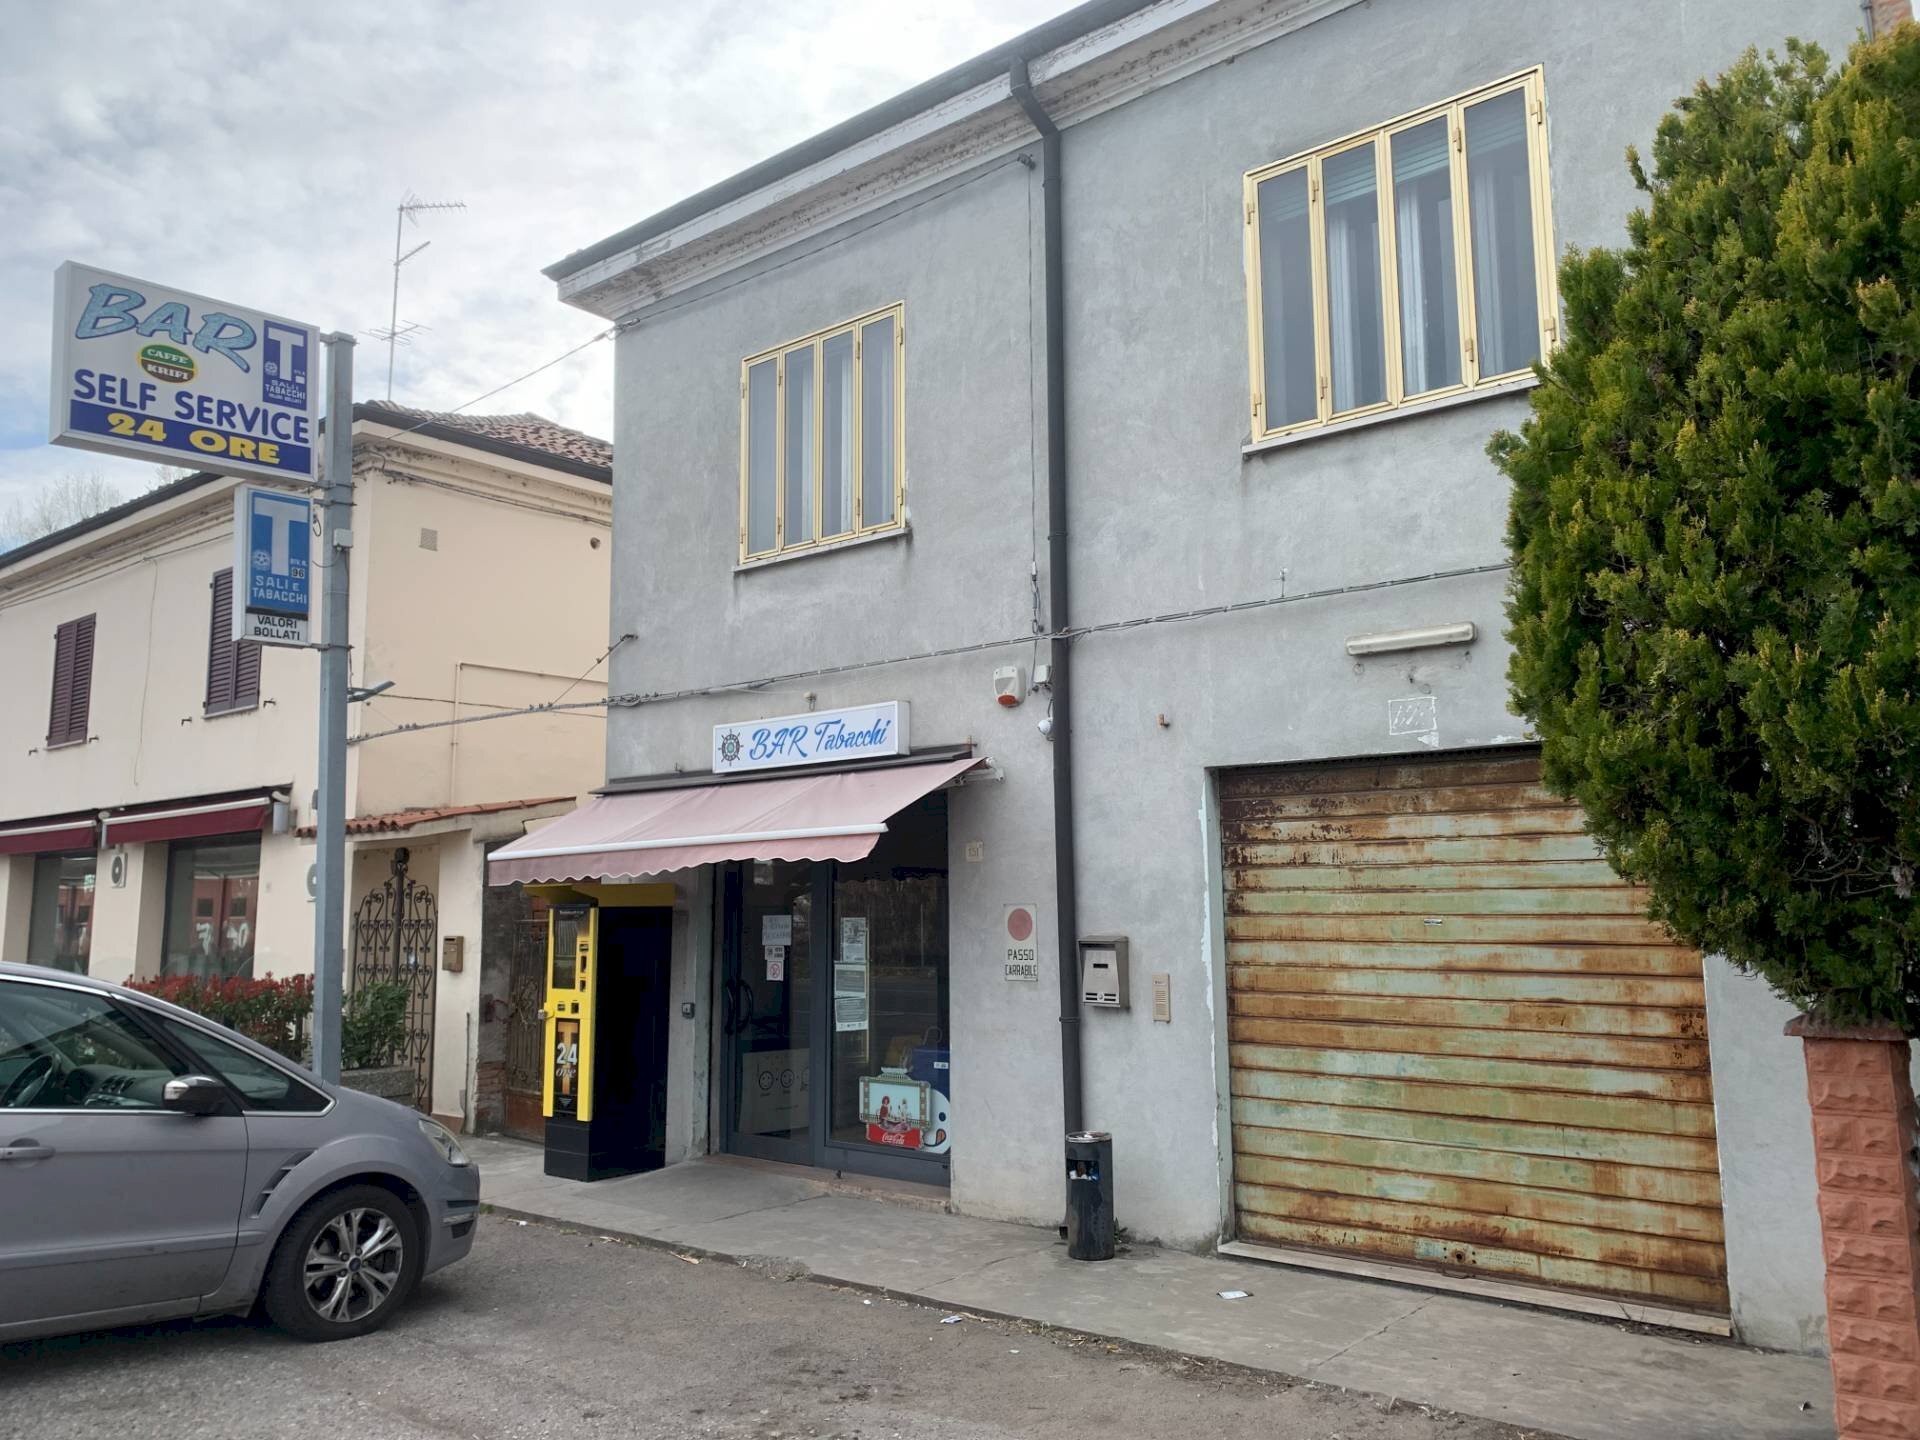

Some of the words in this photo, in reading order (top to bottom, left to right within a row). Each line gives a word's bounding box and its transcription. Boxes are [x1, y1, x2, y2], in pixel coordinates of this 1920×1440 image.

[75, 283, 257, 373] BAR
[265, 383, 305, 400] TABACCHI
[73, 368, 156, 411] SELF
[174, 391, 310, 444] SERVICE
[107, 412, 167, 442] 24
[189, 430, 280, 465] ORE
[256, 575, 289, 590] SALI
[252, 587, 307, 604] TABACCHI
[257, 615, 297, 629] VALORI
[254, 626, 300, 641] BOLLATI
[750, 725, 808, 760] BAR
[814, 718, 891, 753] Tabacchi
[1007, 949, 1034, 960] PASSO
[1005, 964, 1037, 976] CARRABILE
[556, 1042, 578, 1066] 24
